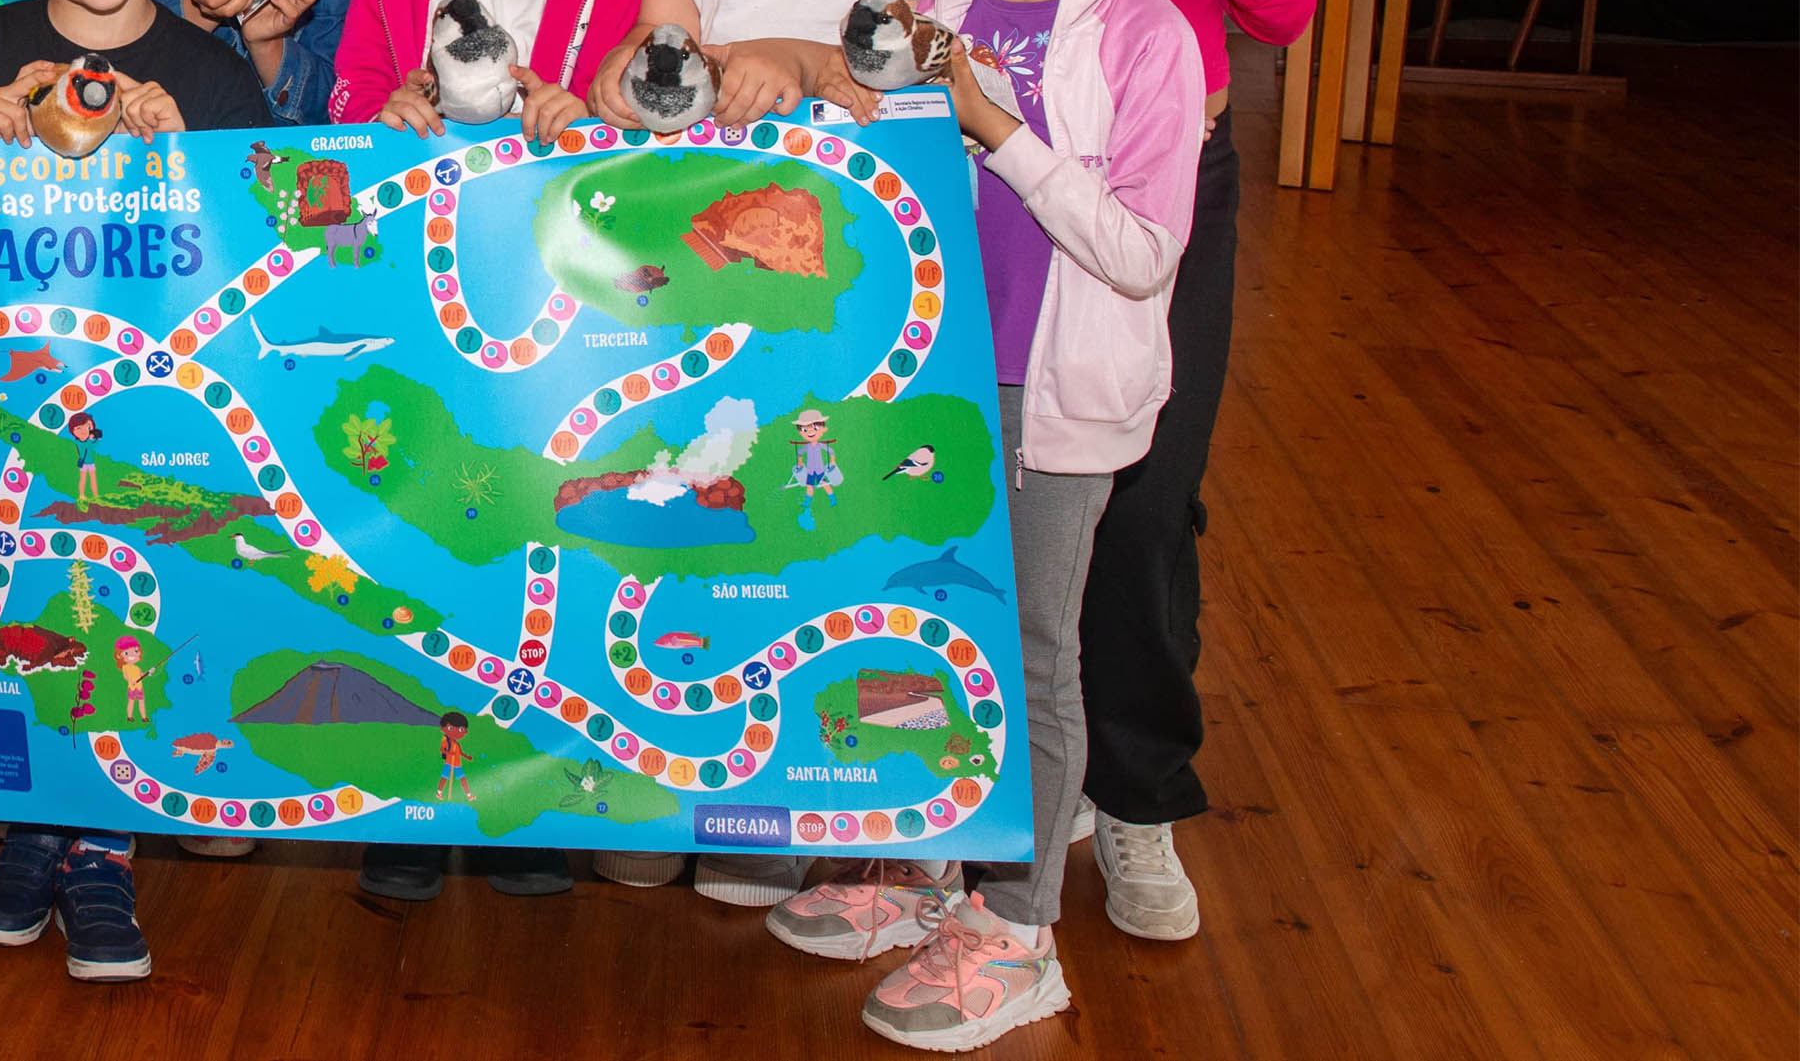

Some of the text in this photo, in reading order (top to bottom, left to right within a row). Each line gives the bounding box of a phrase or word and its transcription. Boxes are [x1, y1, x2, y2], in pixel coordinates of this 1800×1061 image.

[311, 134, 373, 152] GRACIOSA
[760, 126, 770, 145] ?
[145, 150, 186, 181] as
[469, 151, 487, 166] +2
[856, 156, 866, 177] ?
[408, 175, 427, 189] V/F
[878, 179, 897, 193] V/F
[43, 182, 202, 224] Protegidas
[385, 185, 394, 205] ?
[430, 224, 449, 237] V/F
[917, 231, 926, 252] ?
[435, 250, 445, 269] ?
[247, 275, 266, 289] V/F
[919, 267, 938, 281] V/F
[227, 291, 237, 311] ?
[919, 297, 932, 312] -1
[58, 311, 67, 331] ?
[443, 309, 462, 323] V/F
[89, 321, 106, 334] V/F
[174, 336, 193, 349] V/F
[464, 330, 473, 350] ?
[584, 331, 648, 348] TERCEIRA
[710, 340, 729, 353] V/F
[689, 354, 699, 374] ?
[897, 353, 907, 374] ?
[122, 363, 132, 383] ?
[183, 369, 195, 383] -1
[213, 385, 223, 405] ?
[872, 380, 892, 394] V/F
[64, 392, 83, 404] V/F
[603, 391, 612, 411] ?
[47, 406, 56, 426] ?
[230, 415, 250, 428] V/F
[141, 450, 210, 467] SÃO JORGE
[266, 468, 276, 488] ?
[279, 499, 298, 512] V/F
[58, 535, 68, 553] ?
[86, 541, 104, 553] V/F
[536, 550, 547, 570] ?
[138, 574, 148, 593] ?
[712, 582, 790, 599] SÃO MIGUEL
[134, 608, 152, 621] +2
[529, 616, 548, 629] V/F
[894, 614, 908, 629] -1
[618, 615, 628, 634] ?
[829, 619, 849, 633] V/F
[804, 630, 814, 650] ?
[929, 623, 940, 643] ?
[430, 634, 440, 653] ?
[453, 652, 472, 665] V/F
[522, 648, 544, 658] STOP
[613, 647, 632, 662] +2
[952, 646, 972, 660] V/F
[629, 675, 648, 688] V/F
[718, 683, 738, 696] V/F
[692, 688, 703, 708] ?
[500, 698, 510, 719] ?
[565, 703, 584, 716] V/F
[758, 698, 768, 717] ?
[982, 703, 992, 724] ?
[595, 718, 605, 737] ?
[749, 731, 769, 744] V/F
[99, 742, 116, 754] V/F
[643, 754, 662, 769] V/F
[674, 764, 687, 780] -1
[708, 764, 718, 784] ?
[786, 766, 878, 783] SANTA MARIA
[956, 786, 977, 799] V/F
[169, 795, 179, 816] ?
[342, 794, 355, 809] -1
[194, 804, 213, 817] V/F
[258, 802, 267, 823] ?
[282, 806, 301, 819] V/F
[405, 805, 435, 820] PICO
[704, 817, 780, 836] CHEGADA
[800, 823, 823, 833] STOP
